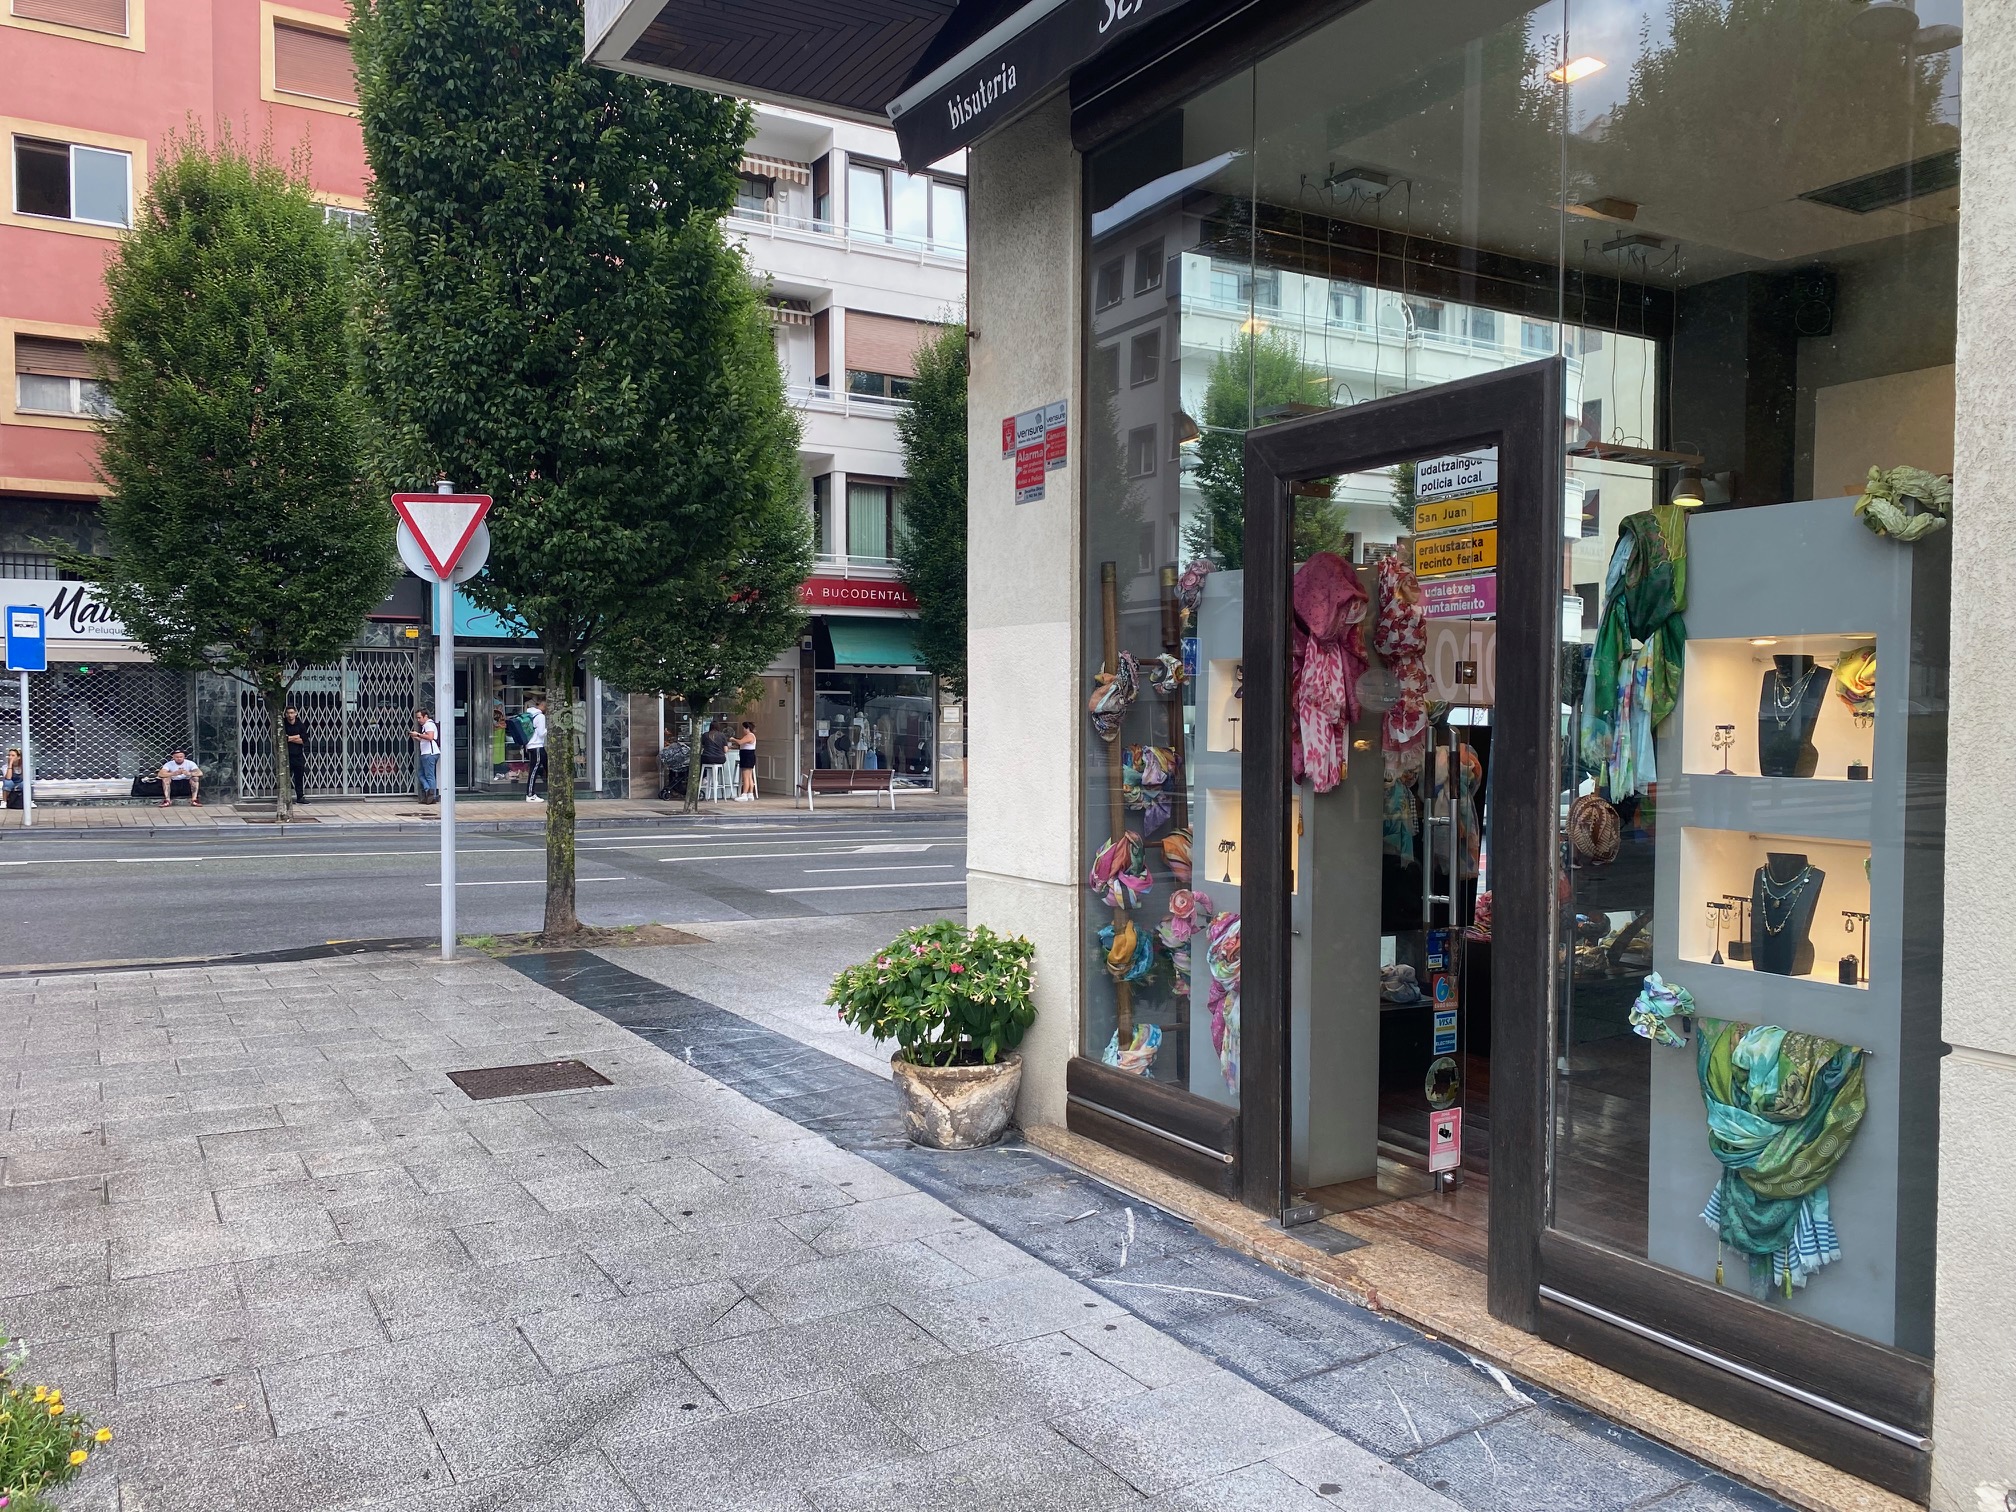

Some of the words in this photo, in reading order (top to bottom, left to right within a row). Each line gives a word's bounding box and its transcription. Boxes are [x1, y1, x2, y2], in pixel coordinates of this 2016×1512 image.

[948, 62, 1017, 130] bisuteria
[1421, 477, 1453, 494] policia
[1457, 471, 1483, 485] local
[1418, 513, 1437, 524] San
[1443, 508, 1467, 520] Juan
[1419, 556, 1453, 570] recinto
[822, 587, 908, 601] BUCODENTAL
[1422, 598, 1486, 616] yuntamiento
[88, 626, 126, 635] Peluque
[1439, 1017, 1453, 1027] VISA
